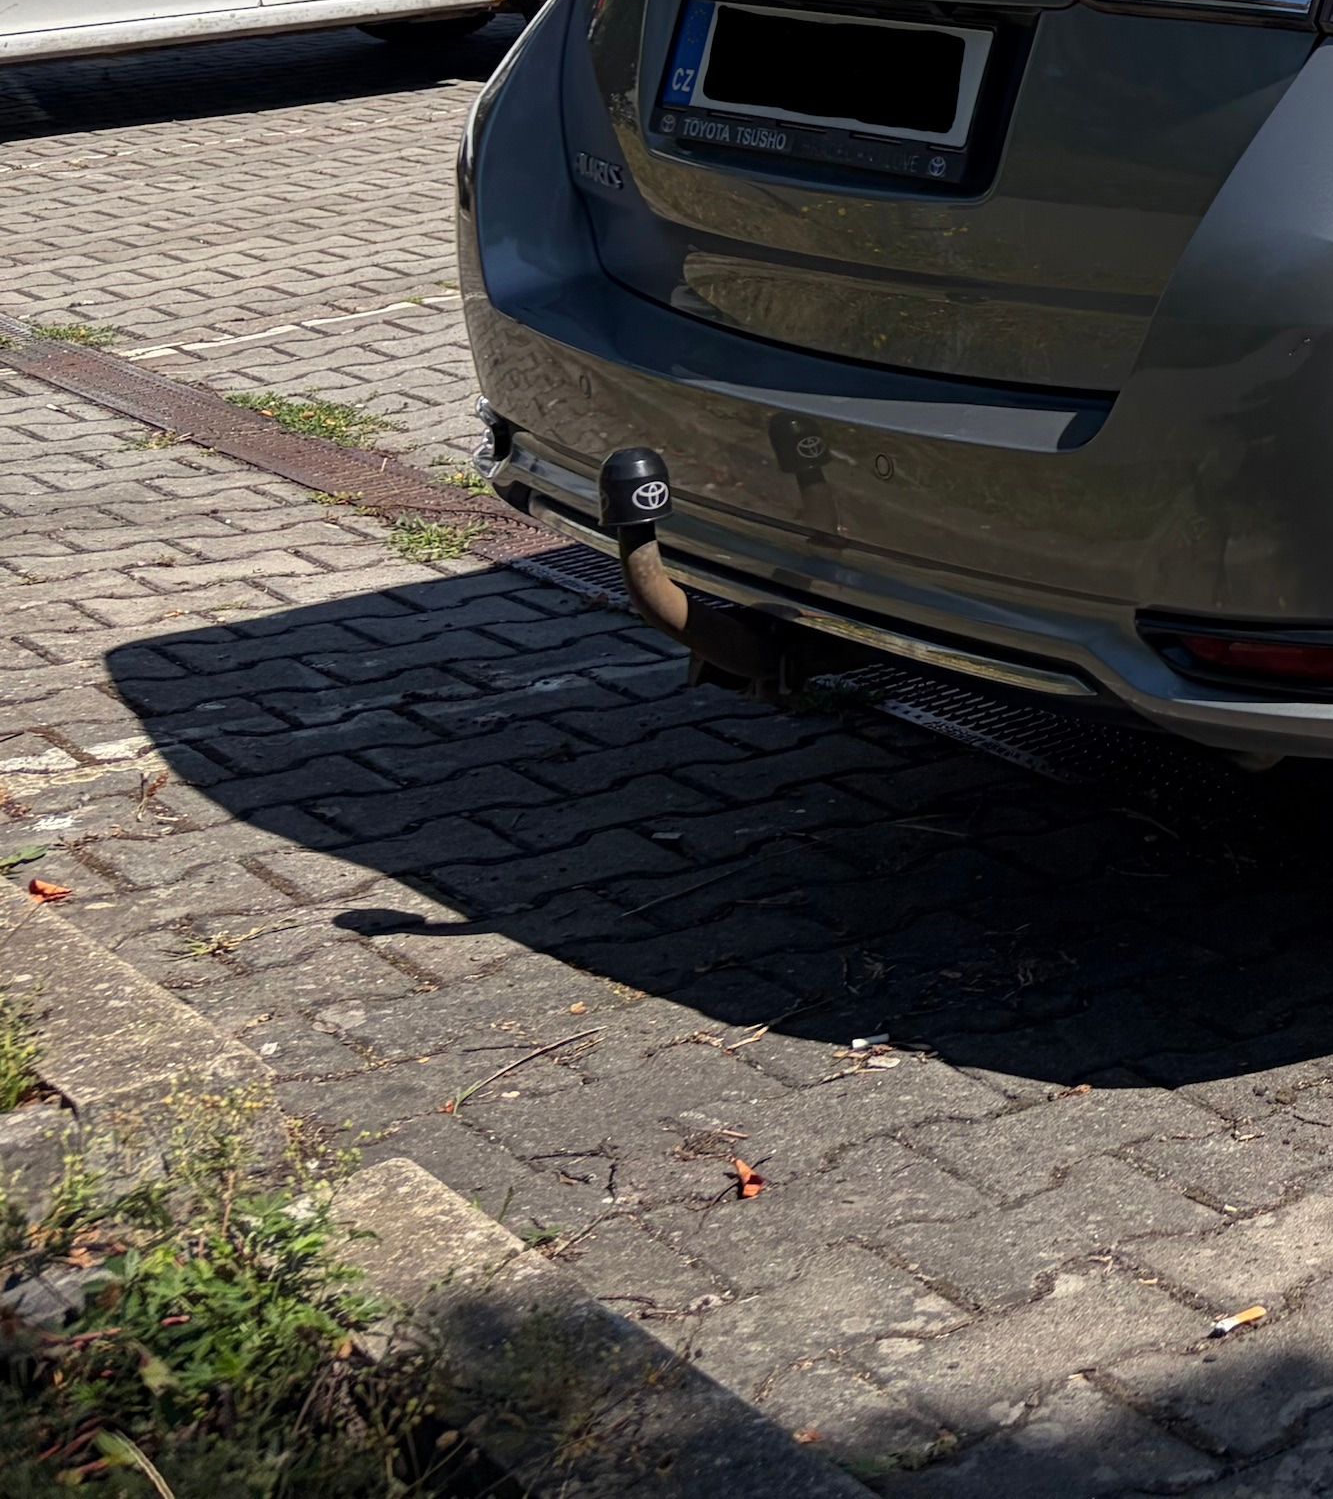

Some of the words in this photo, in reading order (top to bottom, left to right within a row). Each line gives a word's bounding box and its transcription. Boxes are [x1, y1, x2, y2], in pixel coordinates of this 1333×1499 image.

[671, 68, 696, 94] CZ
[682, 117, 731, 144] TOYOTA
[734, 125, 787, 151] TSUSHO
